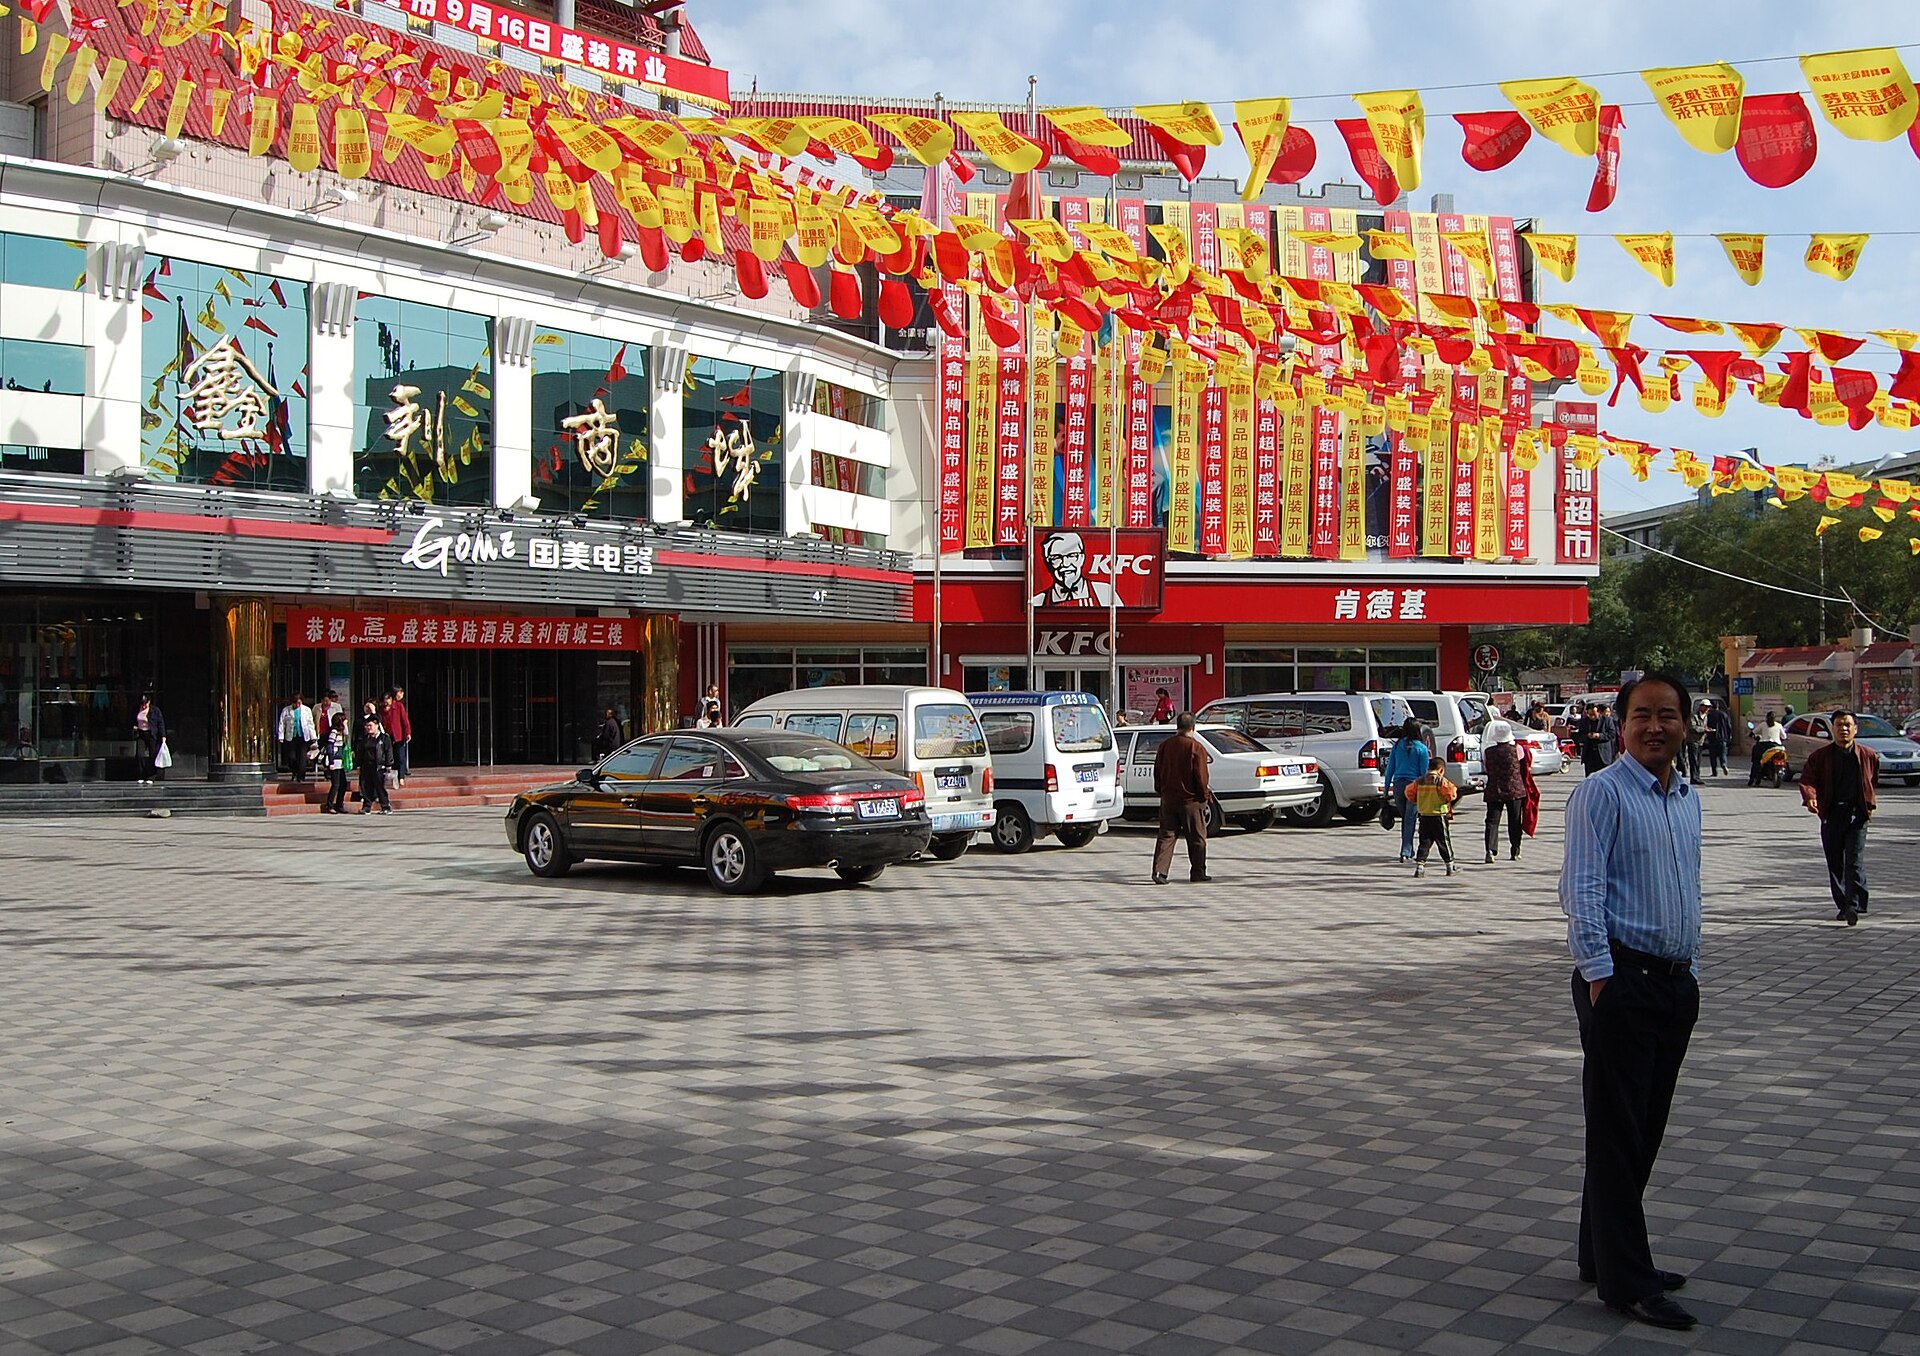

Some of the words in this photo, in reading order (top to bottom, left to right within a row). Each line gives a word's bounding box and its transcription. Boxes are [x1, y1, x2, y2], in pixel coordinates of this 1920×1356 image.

[560, 33, 667, 83] 盛装开业
[1068, 355, 1086, 527] 鑫利精品超市盛装开
[529, 537, 654, 575] 国美电器
[1088, 554, 1154, 576] KFC
[1334, 588, 1427, 620] 肯德基
[306, 616, 346, 643] 恭祝
[401, 618, 624, 647] 盛装登陆酒泉鑫利商城三楼
[1035, 630, 1119, 656] KFC
[1060, 694, 1089, 705] 12315
